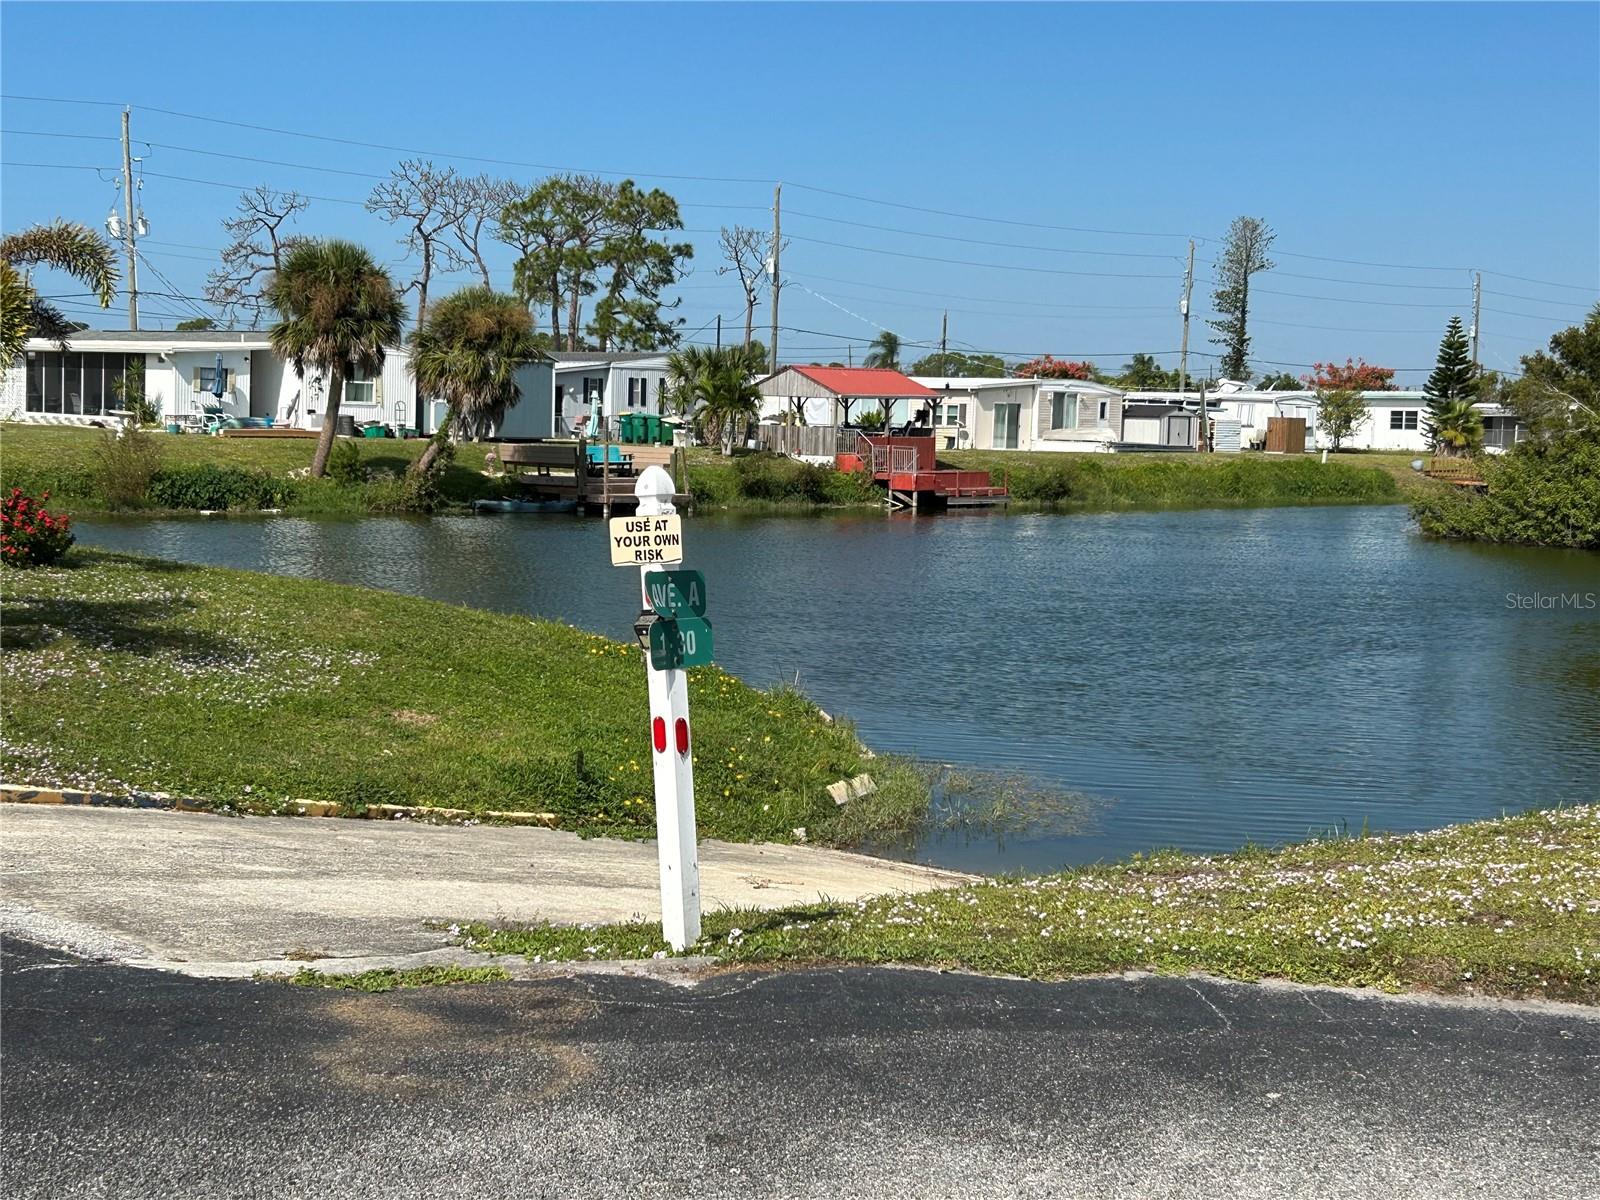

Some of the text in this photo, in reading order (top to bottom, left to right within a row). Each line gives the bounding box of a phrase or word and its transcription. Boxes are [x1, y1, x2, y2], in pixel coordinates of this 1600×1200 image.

[625, 519, 668, 533] USE AT
[614, 534, 679, 548] YOUR OWN
[635, 549, 664, 562] RISK
[652, 581, 700, 608] AVE. A
